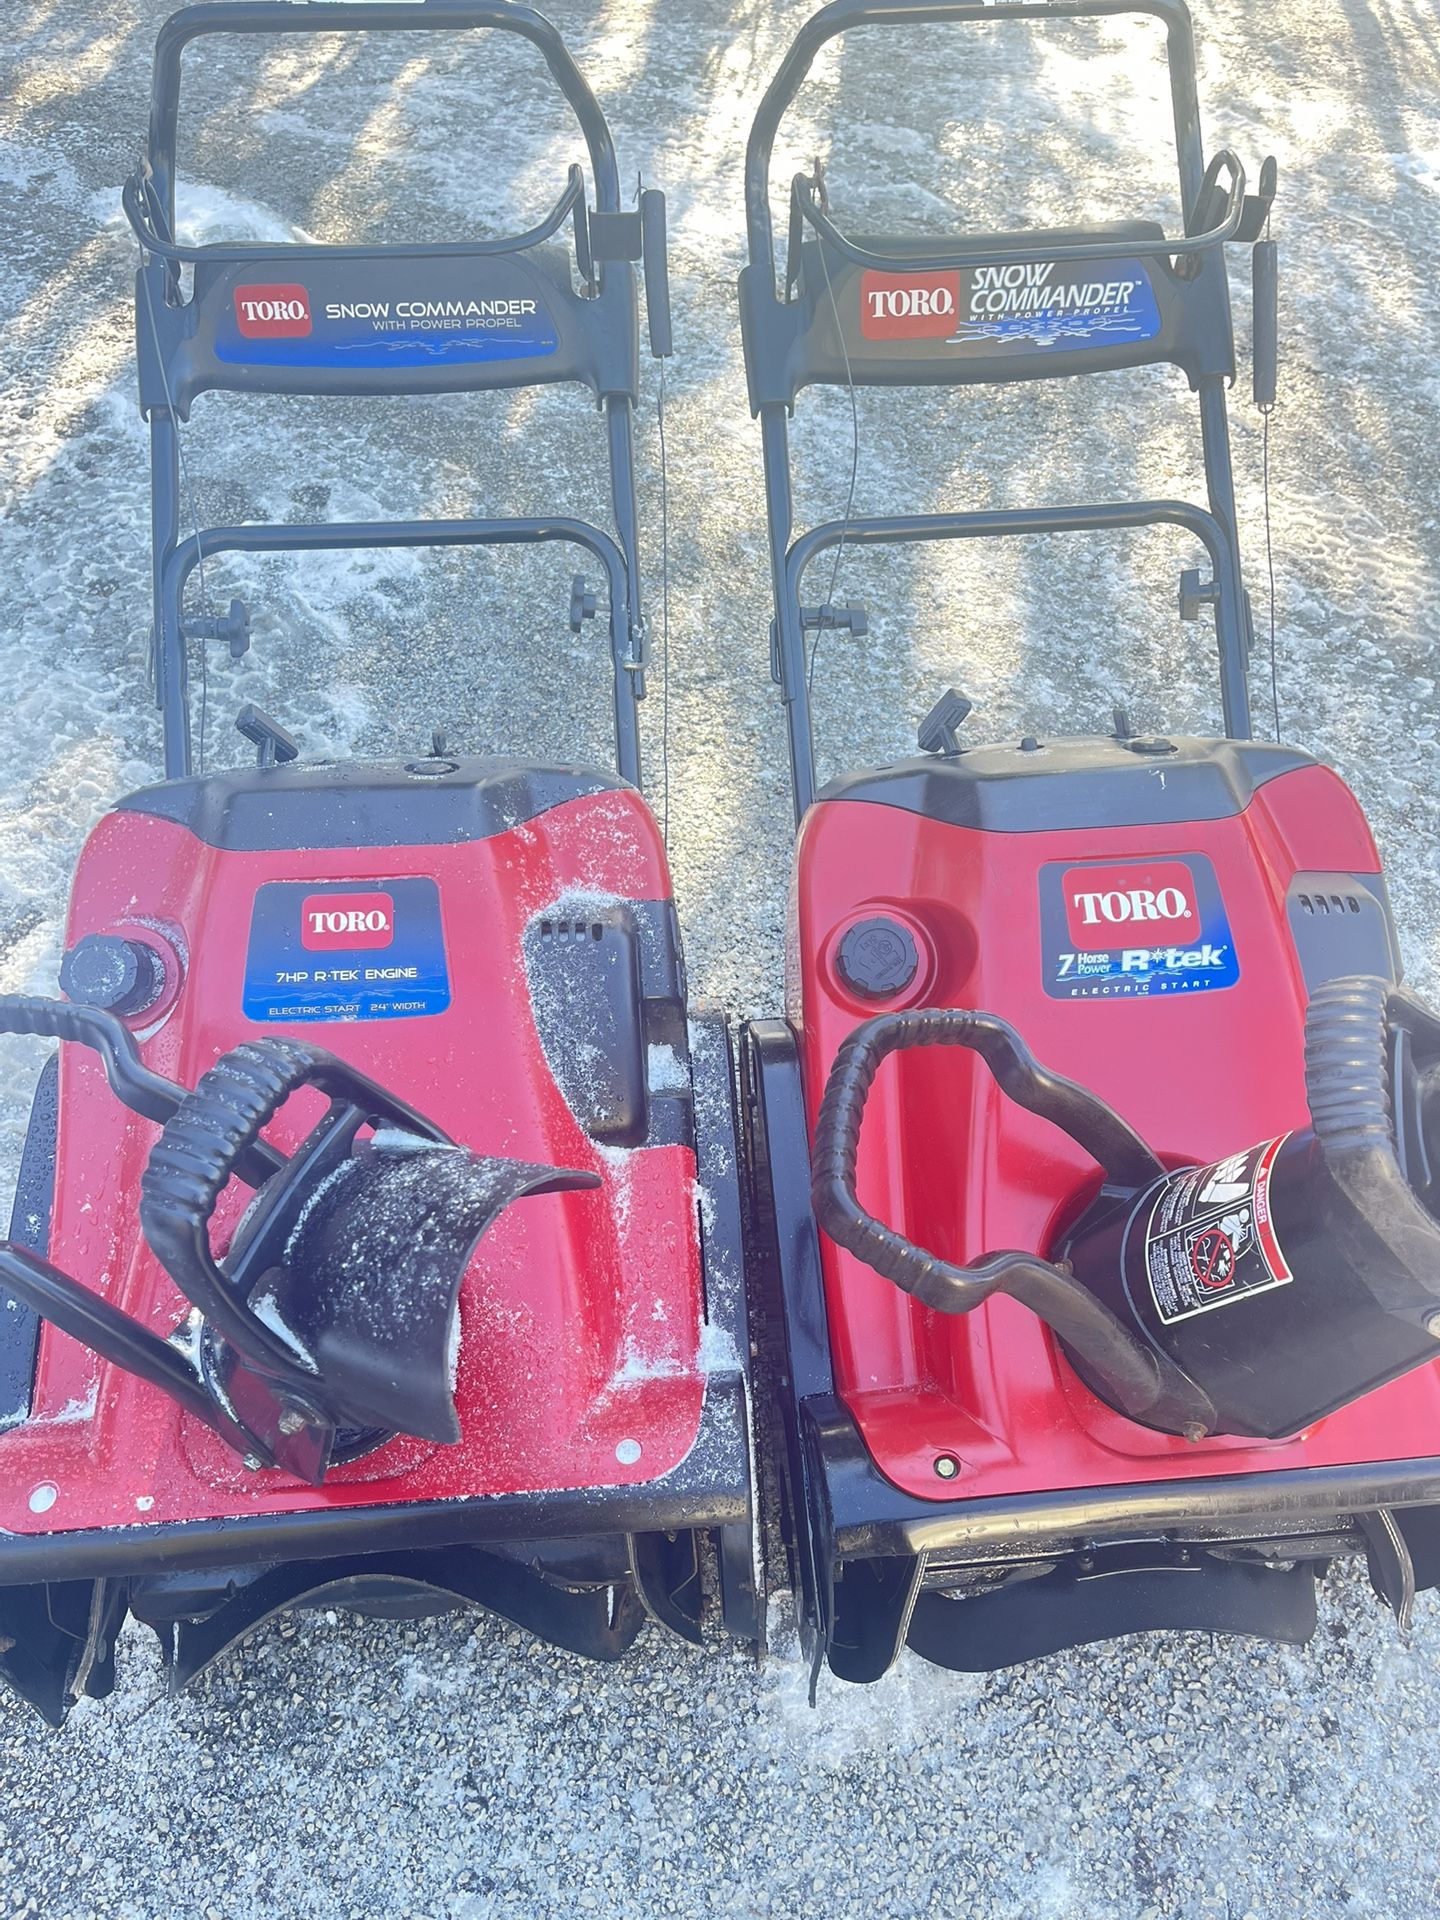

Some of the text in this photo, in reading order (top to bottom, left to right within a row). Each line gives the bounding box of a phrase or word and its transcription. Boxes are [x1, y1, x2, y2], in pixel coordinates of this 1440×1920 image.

[971, 262, 1056, 290] SNOW
[970, 281, 1135, 313] COMMANDER
[325, 300, 537, 319] SNOW COMMANDER
[969, 305, 1129, 322] WITH POWER PROPEL
[372, 317, 522, 330] WITH POWER PROPEL
[1057, 953, 1075, 977] 7
[1077, 952, 1110, 964] Horse
[276, 971, 309, 984] 7HP
[365, 967, 418, 980] ENGINE
[1077, 964, 1112, 975] Power
[1071, 983, 1150, 996] ELECTRIC
[1160, 979, 1210, 990] START
[269, 1005, 321, 1016] ELECTRIC
[324, 1004, 361, 1014] START
[392, 1001, 426, 1010] WIDTH
[1256, 1182, 1268, 1225] DANGER
